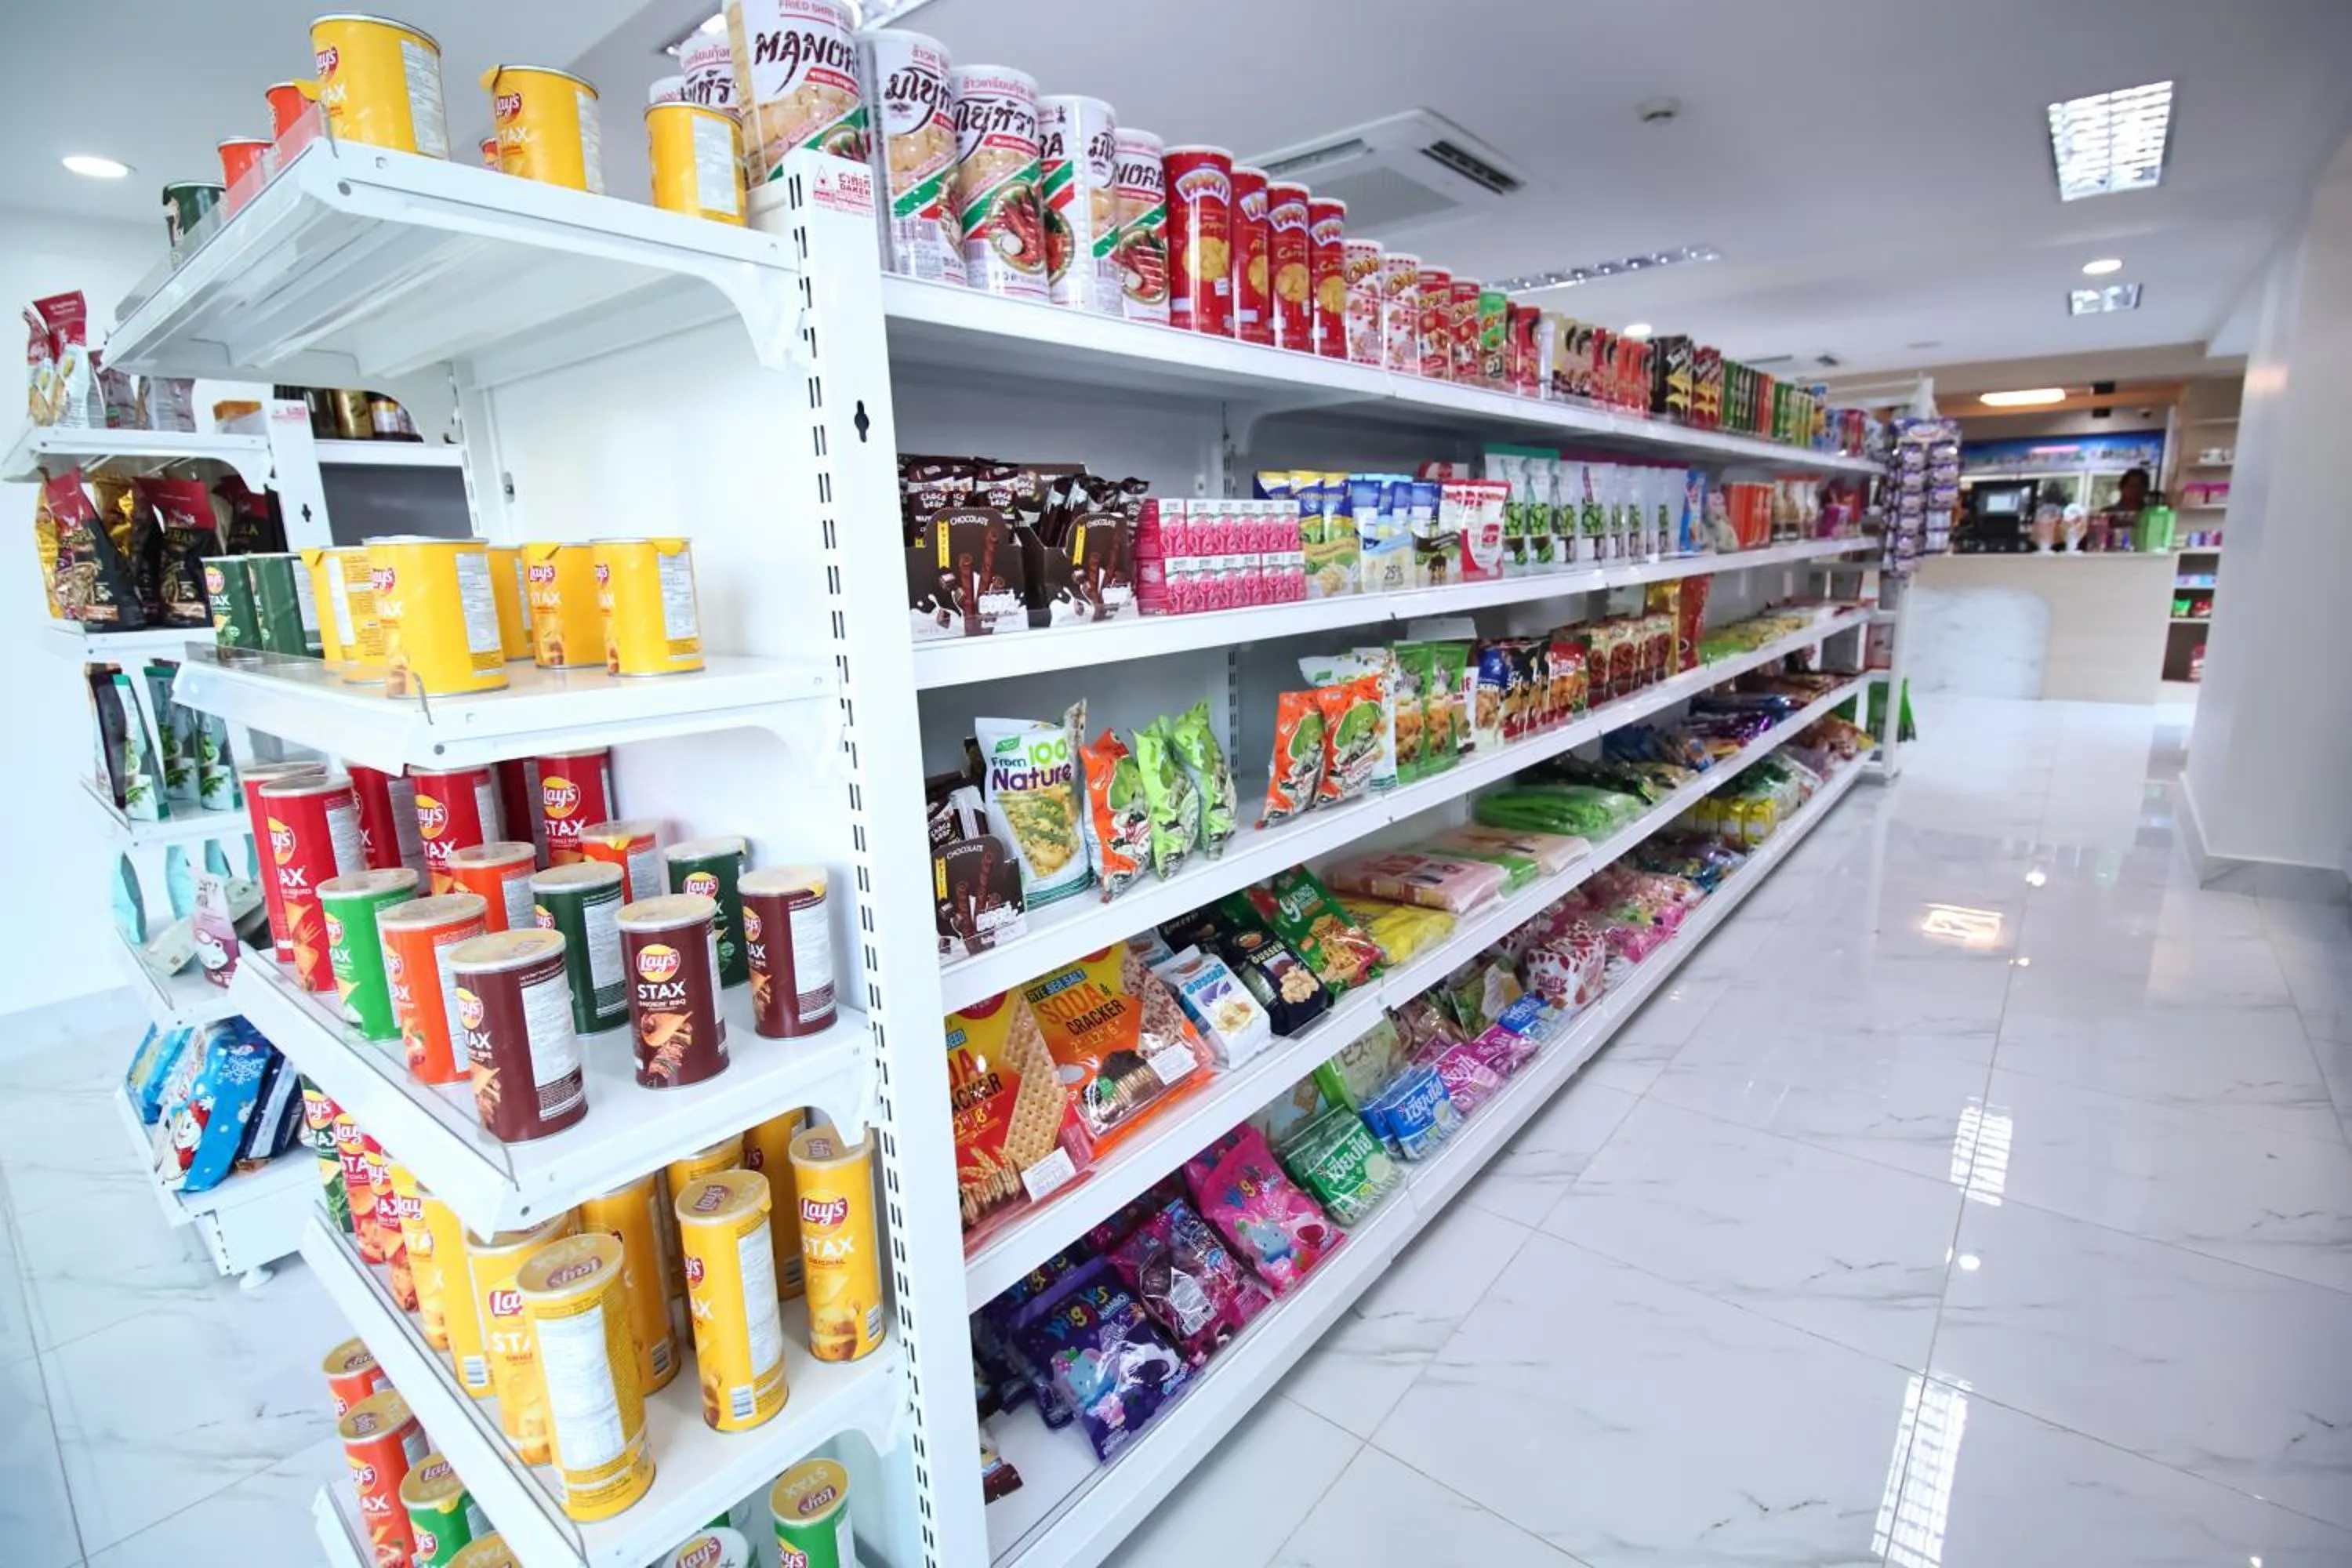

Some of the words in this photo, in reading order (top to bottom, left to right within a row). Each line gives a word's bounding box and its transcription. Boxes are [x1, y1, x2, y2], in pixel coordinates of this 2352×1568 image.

[754, 30, 860, 95] MANOR
[949, 514, 989, 526] CHOCOLATE
[991, 757, 1027, 768] From
[1028, 738, 1068, 765] 100
[991, 763, 1073, 790] Nature
[543, 785, 577, 809] Lay's
[946, 844, 984, 859] CHOCOLATE
[640, 951, 677, 973] Lay's
[637, 980, 687, 1000] STAX
[1026, 985, 1047, 1004] RYE
[1045, 978, 1062, 995] SEA
[1061, 969, 1087, 988] SALT
[1036, 982, 1109, 1025] SODA
[1065, 999, 1127, 1036] CRACKER
[802, 1196, 848, 1225] Lay's
